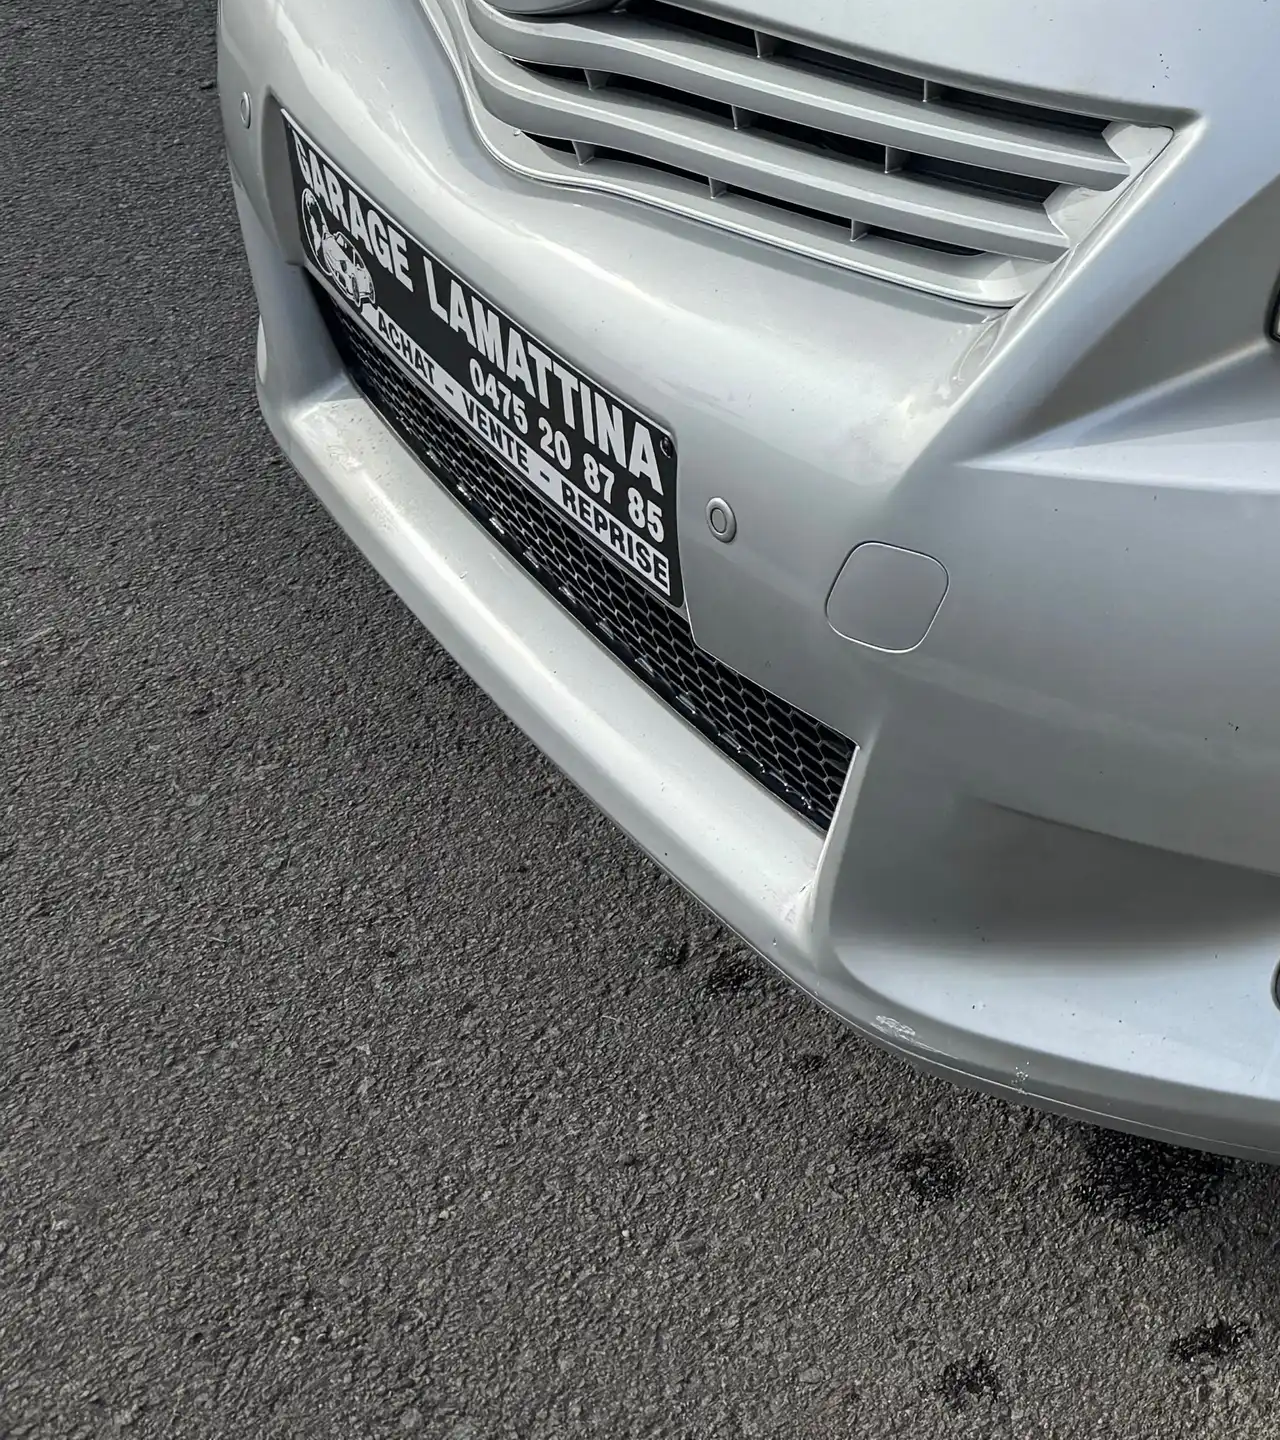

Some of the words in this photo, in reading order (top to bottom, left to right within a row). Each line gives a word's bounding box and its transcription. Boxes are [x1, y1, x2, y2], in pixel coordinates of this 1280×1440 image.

[291, 129, 414, 293] GARAGE
[423, 256, 664, 496] LAMATTINA
[377, 310, 435, 386] ACHAT
[461, 390, 530, 474] VENTE
[561, 482, 669, 589] REPRISE
[469, 358, 529, 435] 0475
[538, 417, 572, 471] 20
[583, 453, 615, 505] 87
[628, 487, 665, 544] 85
